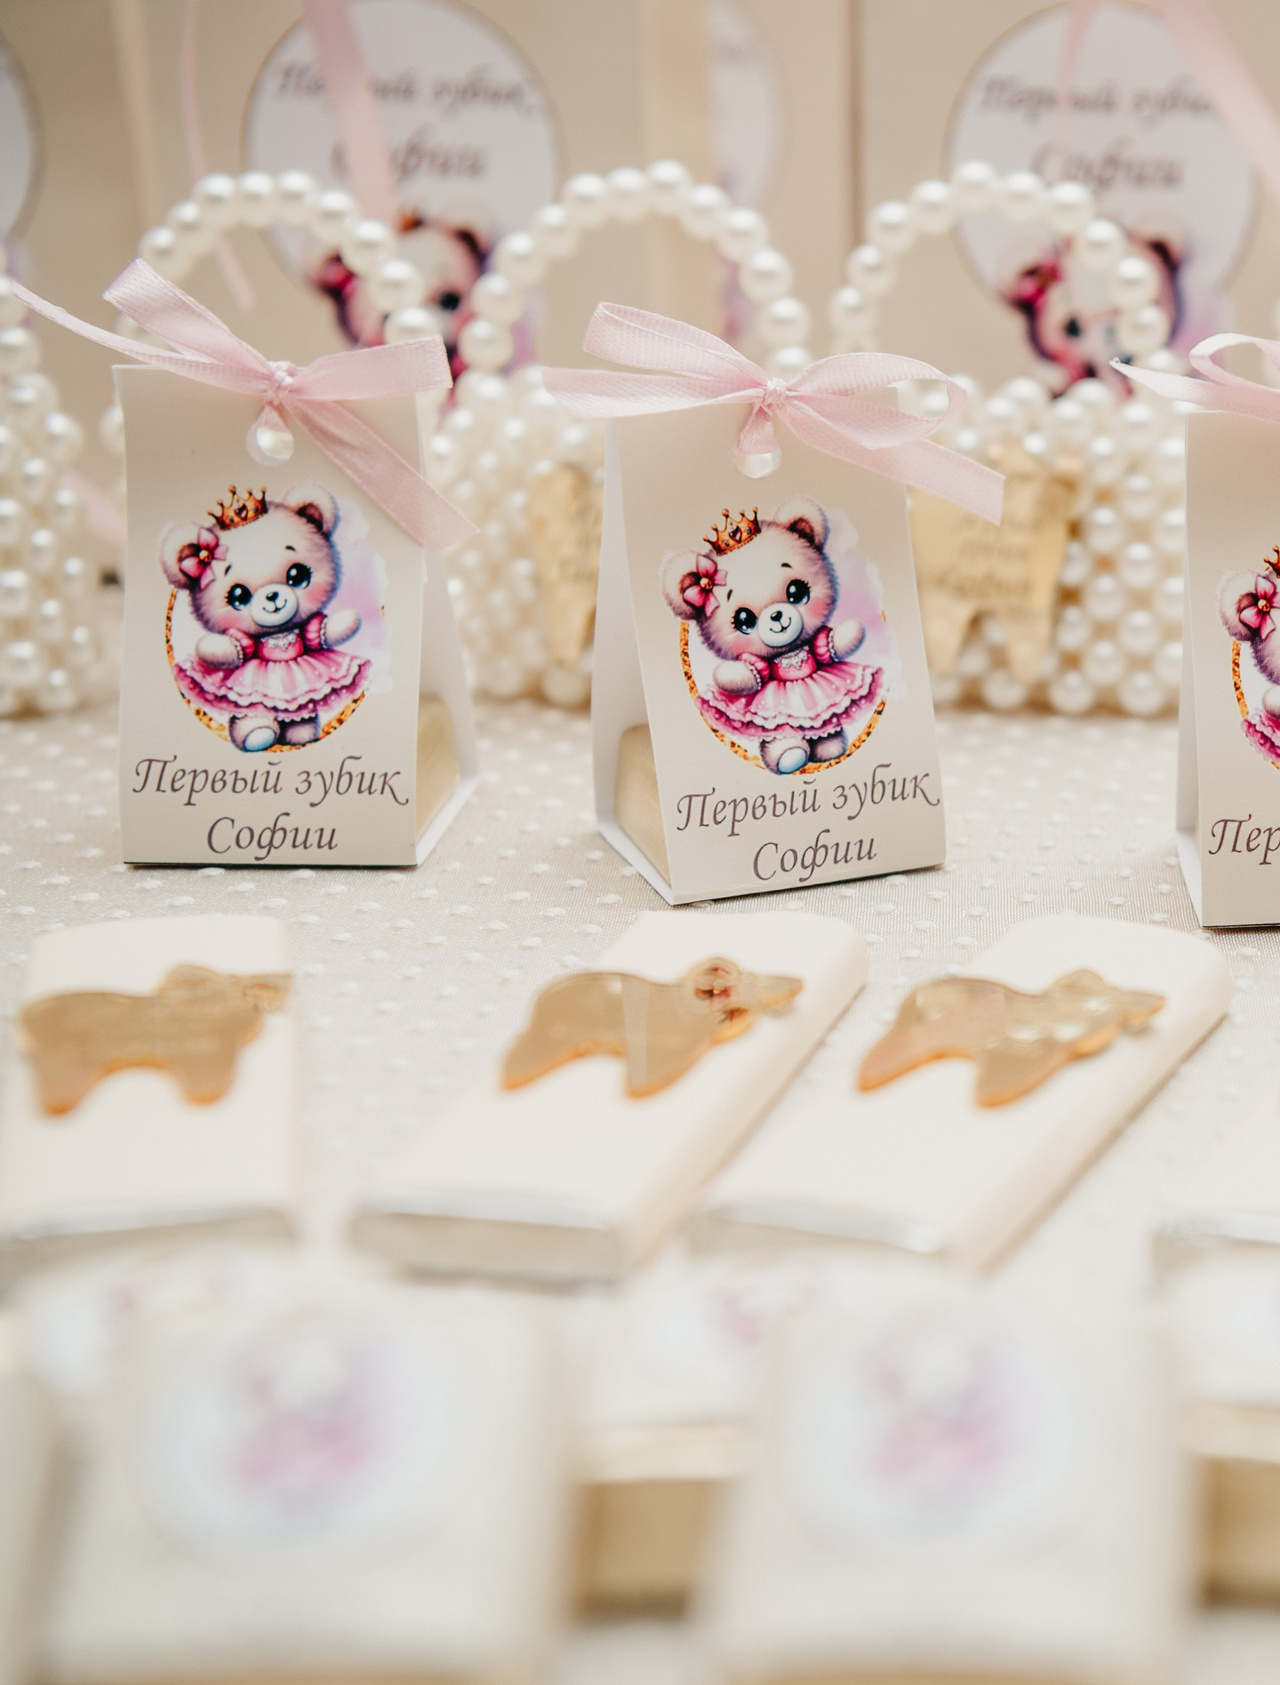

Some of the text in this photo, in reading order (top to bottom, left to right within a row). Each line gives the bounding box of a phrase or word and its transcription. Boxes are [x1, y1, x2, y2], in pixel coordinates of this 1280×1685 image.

[133, 755, 409, 807] Первый зубик
[676, 763, 940, 836] Первый зубик
[207, 812, 338, 861] Софии
[753, 829, 877, 882] Софии
